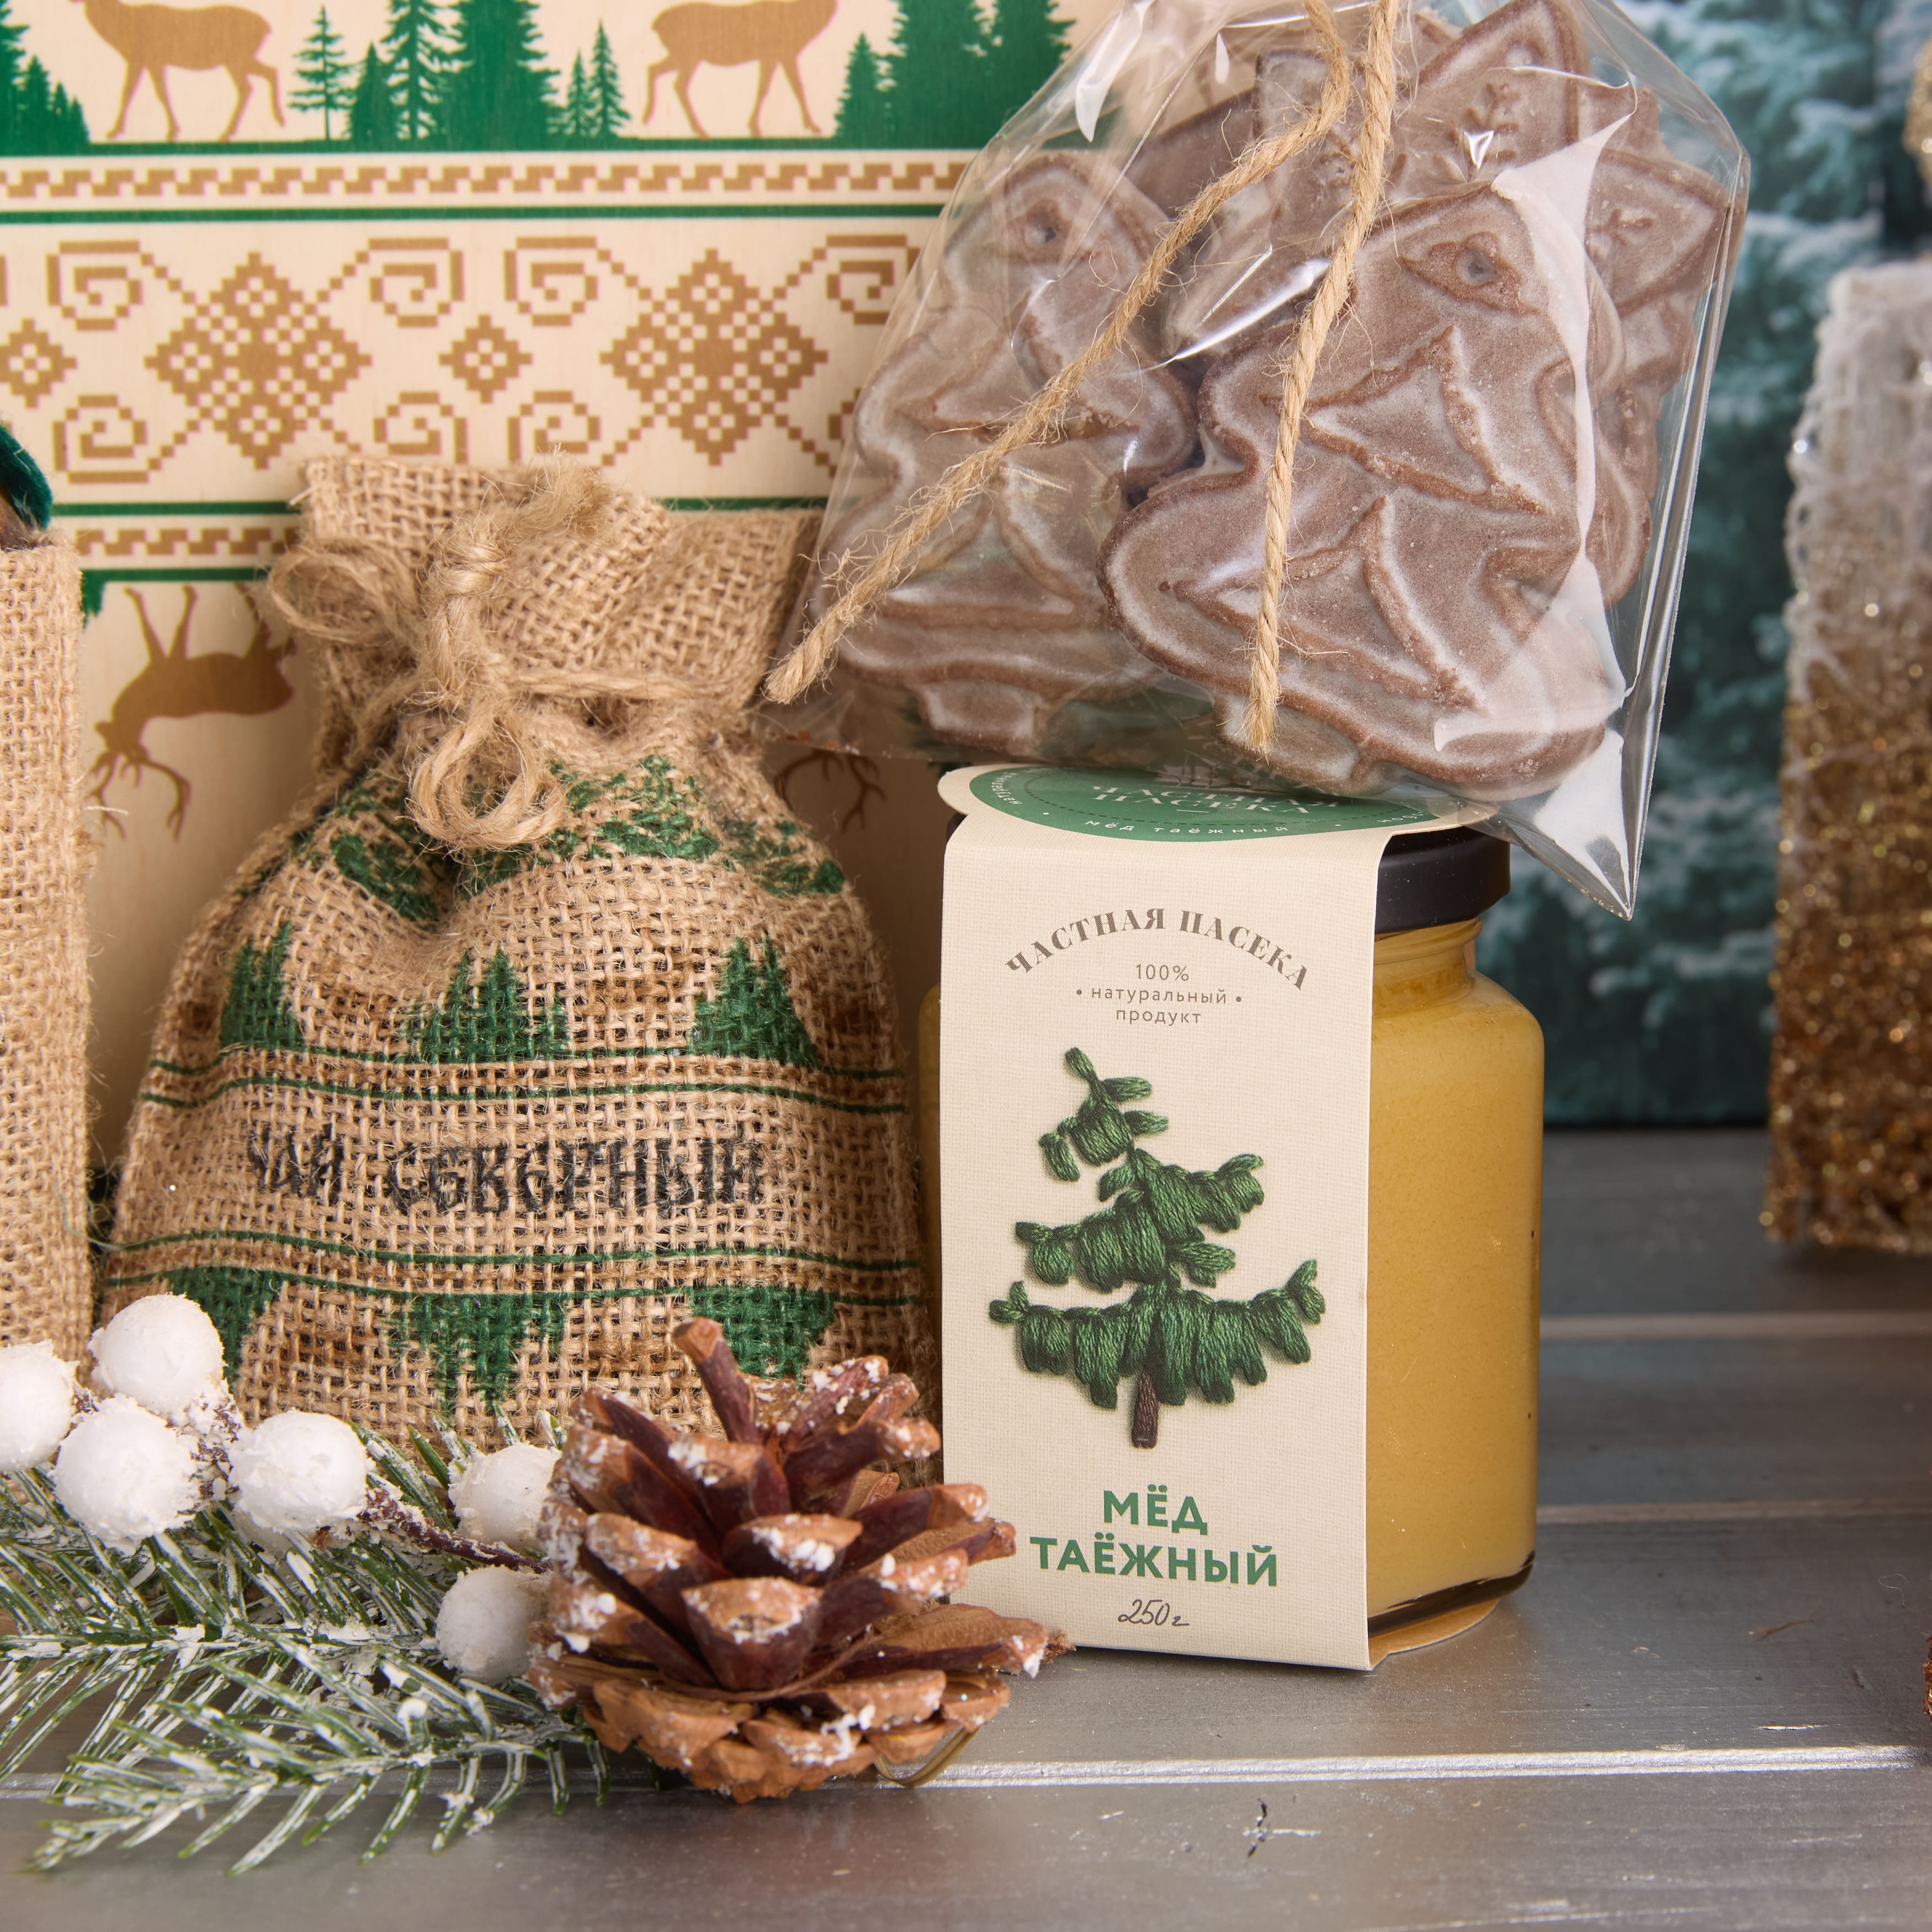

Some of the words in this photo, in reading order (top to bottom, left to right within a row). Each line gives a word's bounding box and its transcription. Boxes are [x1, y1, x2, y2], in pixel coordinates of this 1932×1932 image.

[1091, 794, 1310, 813] ПАСЕКА
[1092, 786, 1339, 807] ЧАСТНАЯ
[1085, 820, 1135, 831] мёд
[1005, 908, 1166, 974] ЧАСТНАЯ
[1178, 909, 1308, 990] ПАСЕКА
[1135, 964, 1189, 981] 100%
[1091, 986, 1227, 1005] натуральный
[1116, 1009, 1202, 1026] продукт
[1103, 1484, 1208, 1536] МЁД
[1029, 1532, 1277, 1587] ТАЁЖНЫЙ
